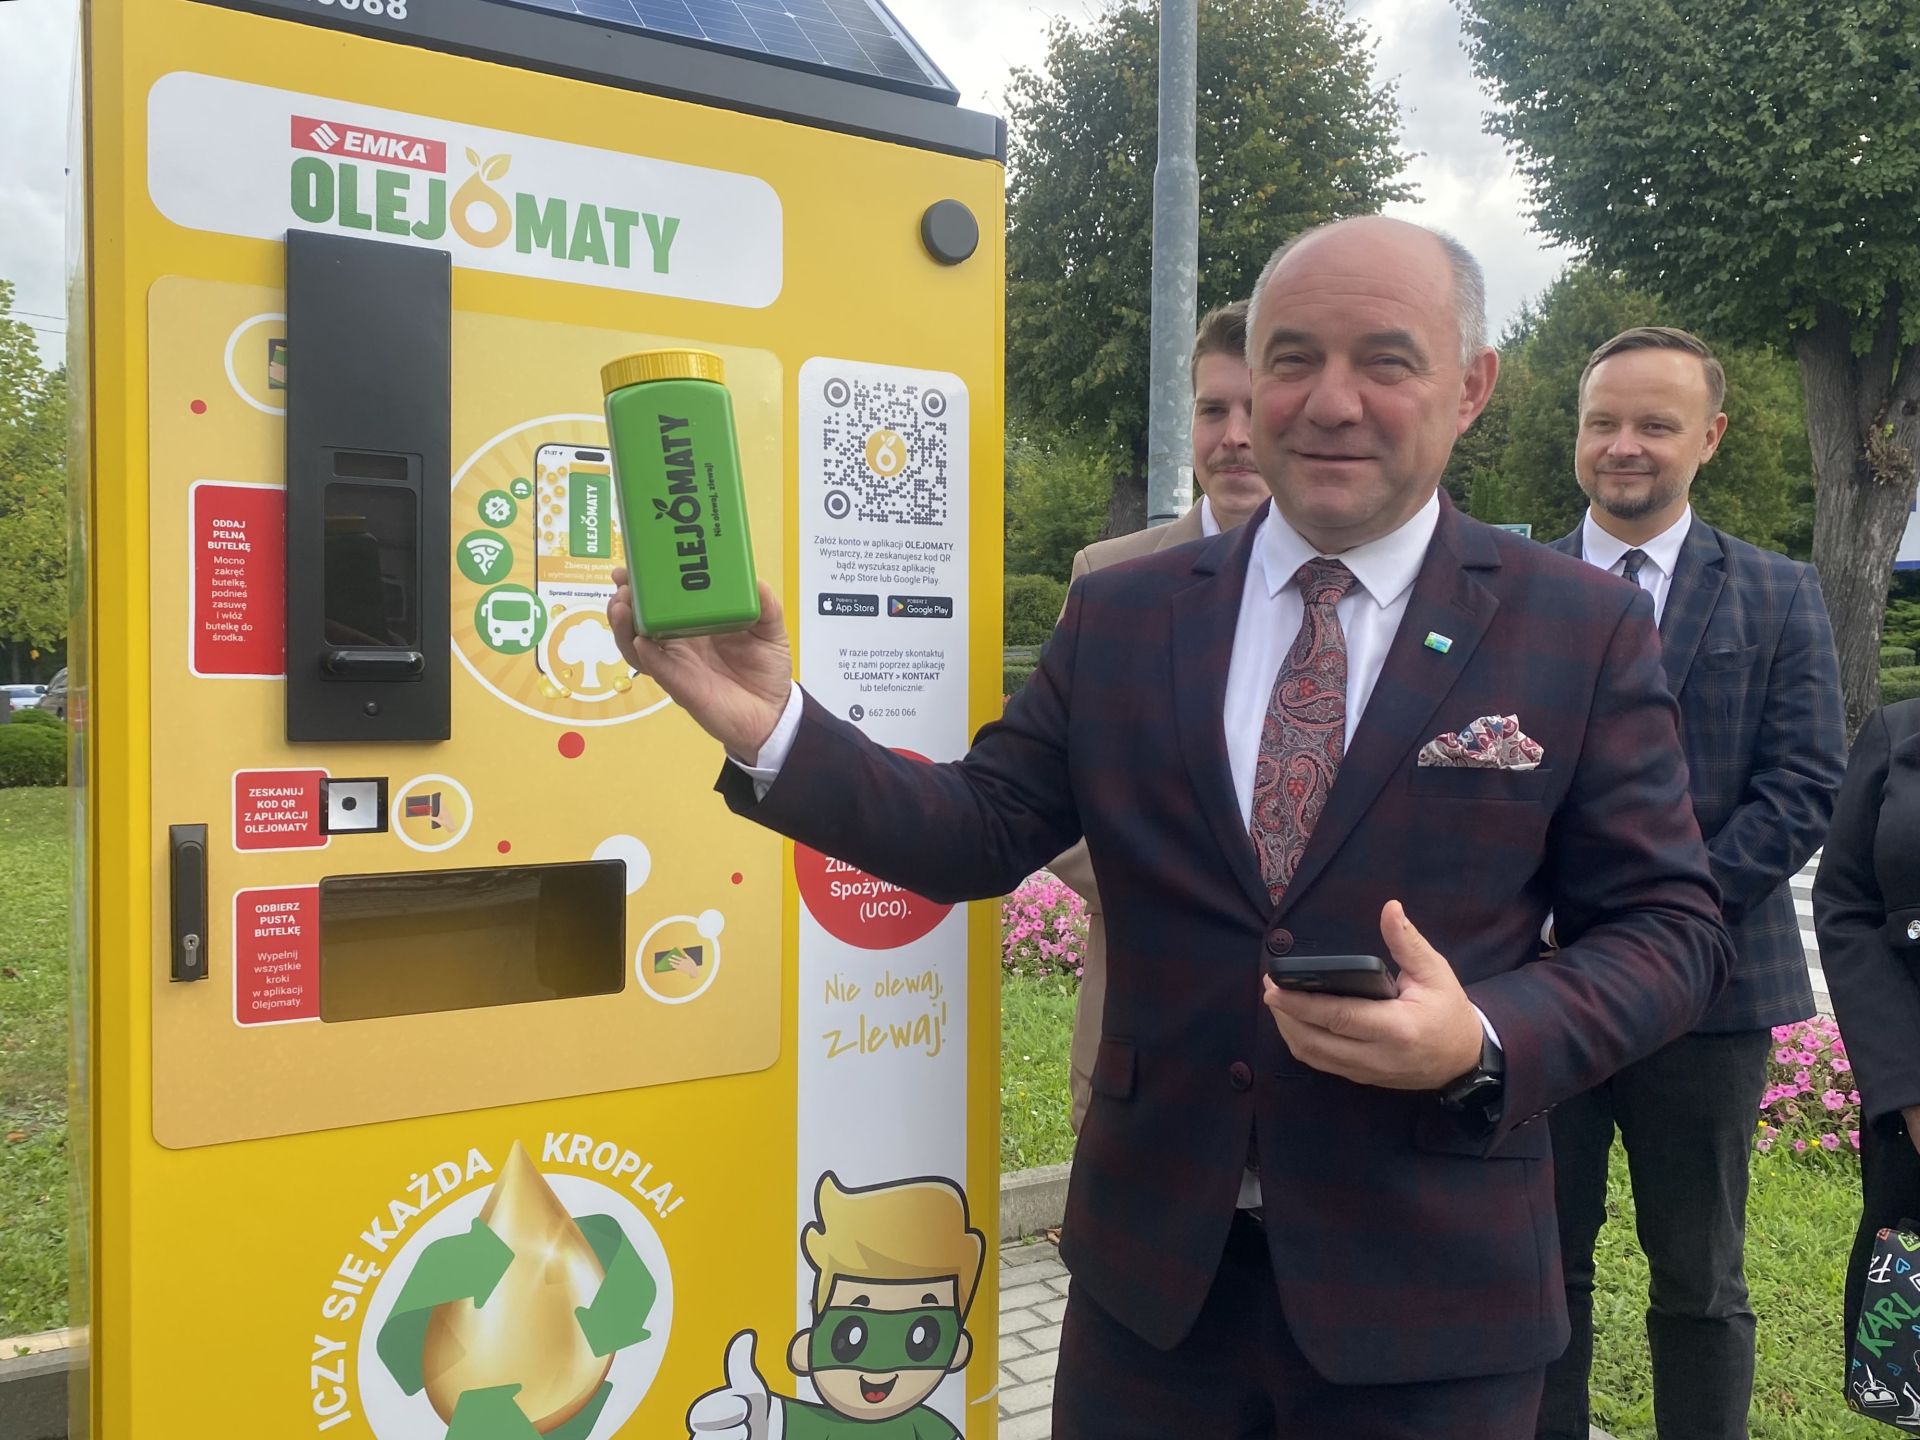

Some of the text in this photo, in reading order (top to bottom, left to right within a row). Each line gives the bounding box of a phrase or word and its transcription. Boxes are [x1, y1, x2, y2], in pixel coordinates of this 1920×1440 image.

[344, 130, 428, 164] EMKA
[212, 519, 246, 529] ODDAJ
[213, 530, 246, 541] PEŁNĄ
[207, 541, 252, 552] BUTELKĘ
[814, 536, 837, 545] Załóż
[838, 537, 861, 546] konto
[871, 539, 903, 550] aplikacji
[905, 541, 954, 551] OLEJOMATY
[213, 556, 246, 565] Mocno
[820, 548, 951, 562] Wystarczy, że zeskanujesz kod QR
[214, 567, 245, 577] zakręć
[836, 561, 936, 575] bądź wyszukasz aplikację
[211, 578, 248, 588] butelkę,
[839, 573, 855, 583] App
[857, 573, 878, 582] Store
[880, 574, 892, 583] lub
[893, 574, 920, 585] Google
[211, 589, 248, 599] podnieś
[212, 601, 247, 611] zasuwę
[835, 603, 875, 613] App Store
[907, 605, 949, 616] Google Play
[221, 611, 243, 620] włóż
[205, 621, 253, 632] butelkę do
[212, 632, 246, 642] środka.
[839, 648, 944, 659] W razie potrzeby skontaktuj
[839, 661, 850, 670] się
[858, 661, 878, 669] nami
[879, 663, 910, 672] poprzez
[912, 661, 945, 671] aplikację
[843, 672, 894, 680] OLEJOMATY
[902, 672, 940, 680] KONTAKT
[860, 683, 872, 692] lub
[869, 708, 917, 717] 662 260 066
[249, 788, 304, 798] ZESKANUJ
[257, 800, 296, 809] KOD QR
[244, 811, 308, 821] Z APLIKACJI
[245, 823, 308, 834] OLEJOMATY
[255, 902, 300, 913] ODBIERZ
[860, 898, 912, 923] (UCO).
[260, 914, 296, 926] PUSTĄ
[254, 926, 301, 937] BUTELKĘ
[257, 950, 298, 962] Wypełnij
[254, 963, 302, 974] wszystkie
[266, 975, 290, 984] kroki
[825, 963, 943, 1005] Nie olewaj,
[252, 985, 303, 998] w aplikacji
[322, 1253, 382, 1321] SIĘ
[360, 1148, 494, 1253] KAŻDA
[542, 1132, 685, 1219] KROPLA!
[1857, 1292, 1920, 1359] KARL
